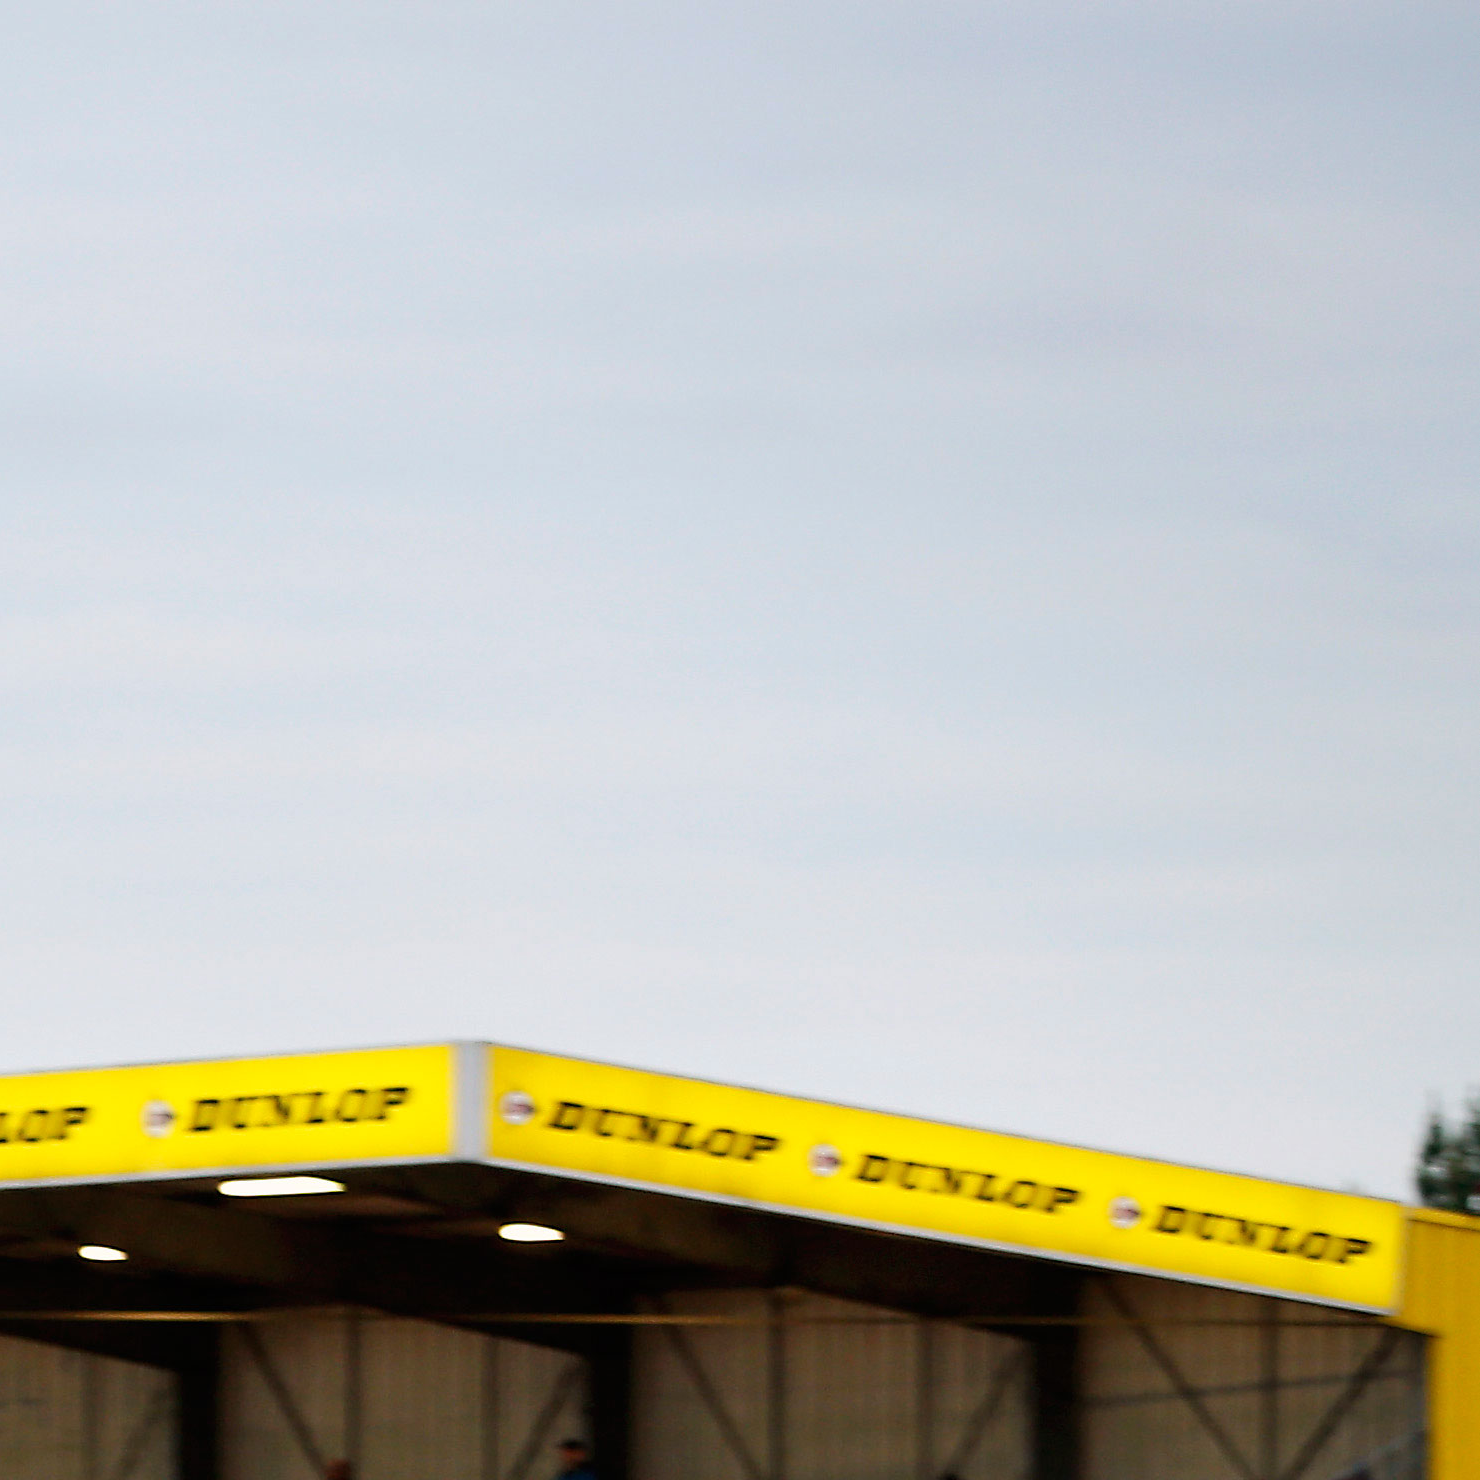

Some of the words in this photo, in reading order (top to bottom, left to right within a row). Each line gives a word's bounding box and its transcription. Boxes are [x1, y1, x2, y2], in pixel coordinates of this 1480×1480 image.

[188, 1086, 410, 1133] DUNLOP
[547, 1100, 781, 1161] DUNLOP
[854, 1154, 1082, 1214] DUNLOP
[1153, 1205, 1374, 1265] DUNLOP
